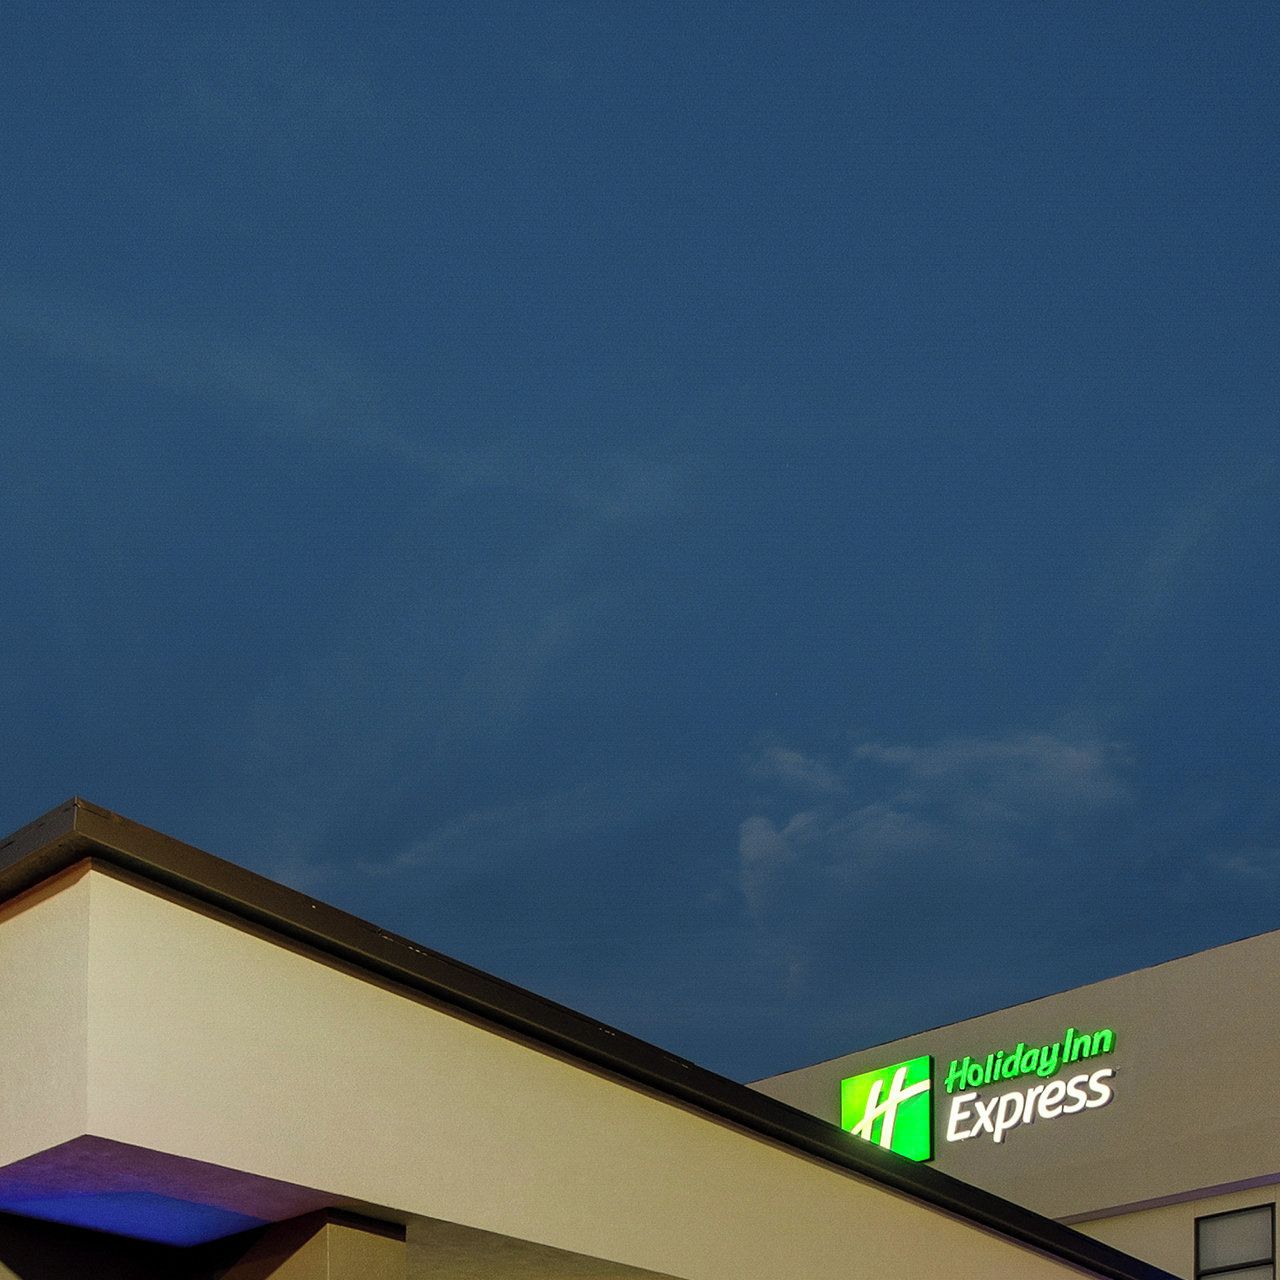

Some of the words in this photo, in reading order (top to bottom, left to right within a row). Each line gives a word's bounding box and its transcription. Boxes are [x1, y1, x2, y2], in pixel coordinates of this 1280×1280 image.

[944, 1043, 1060, 1094] Holiday
[1061, 1027, 1114, 1063] Inn
[946, 1068, 1115, 1143] Express
